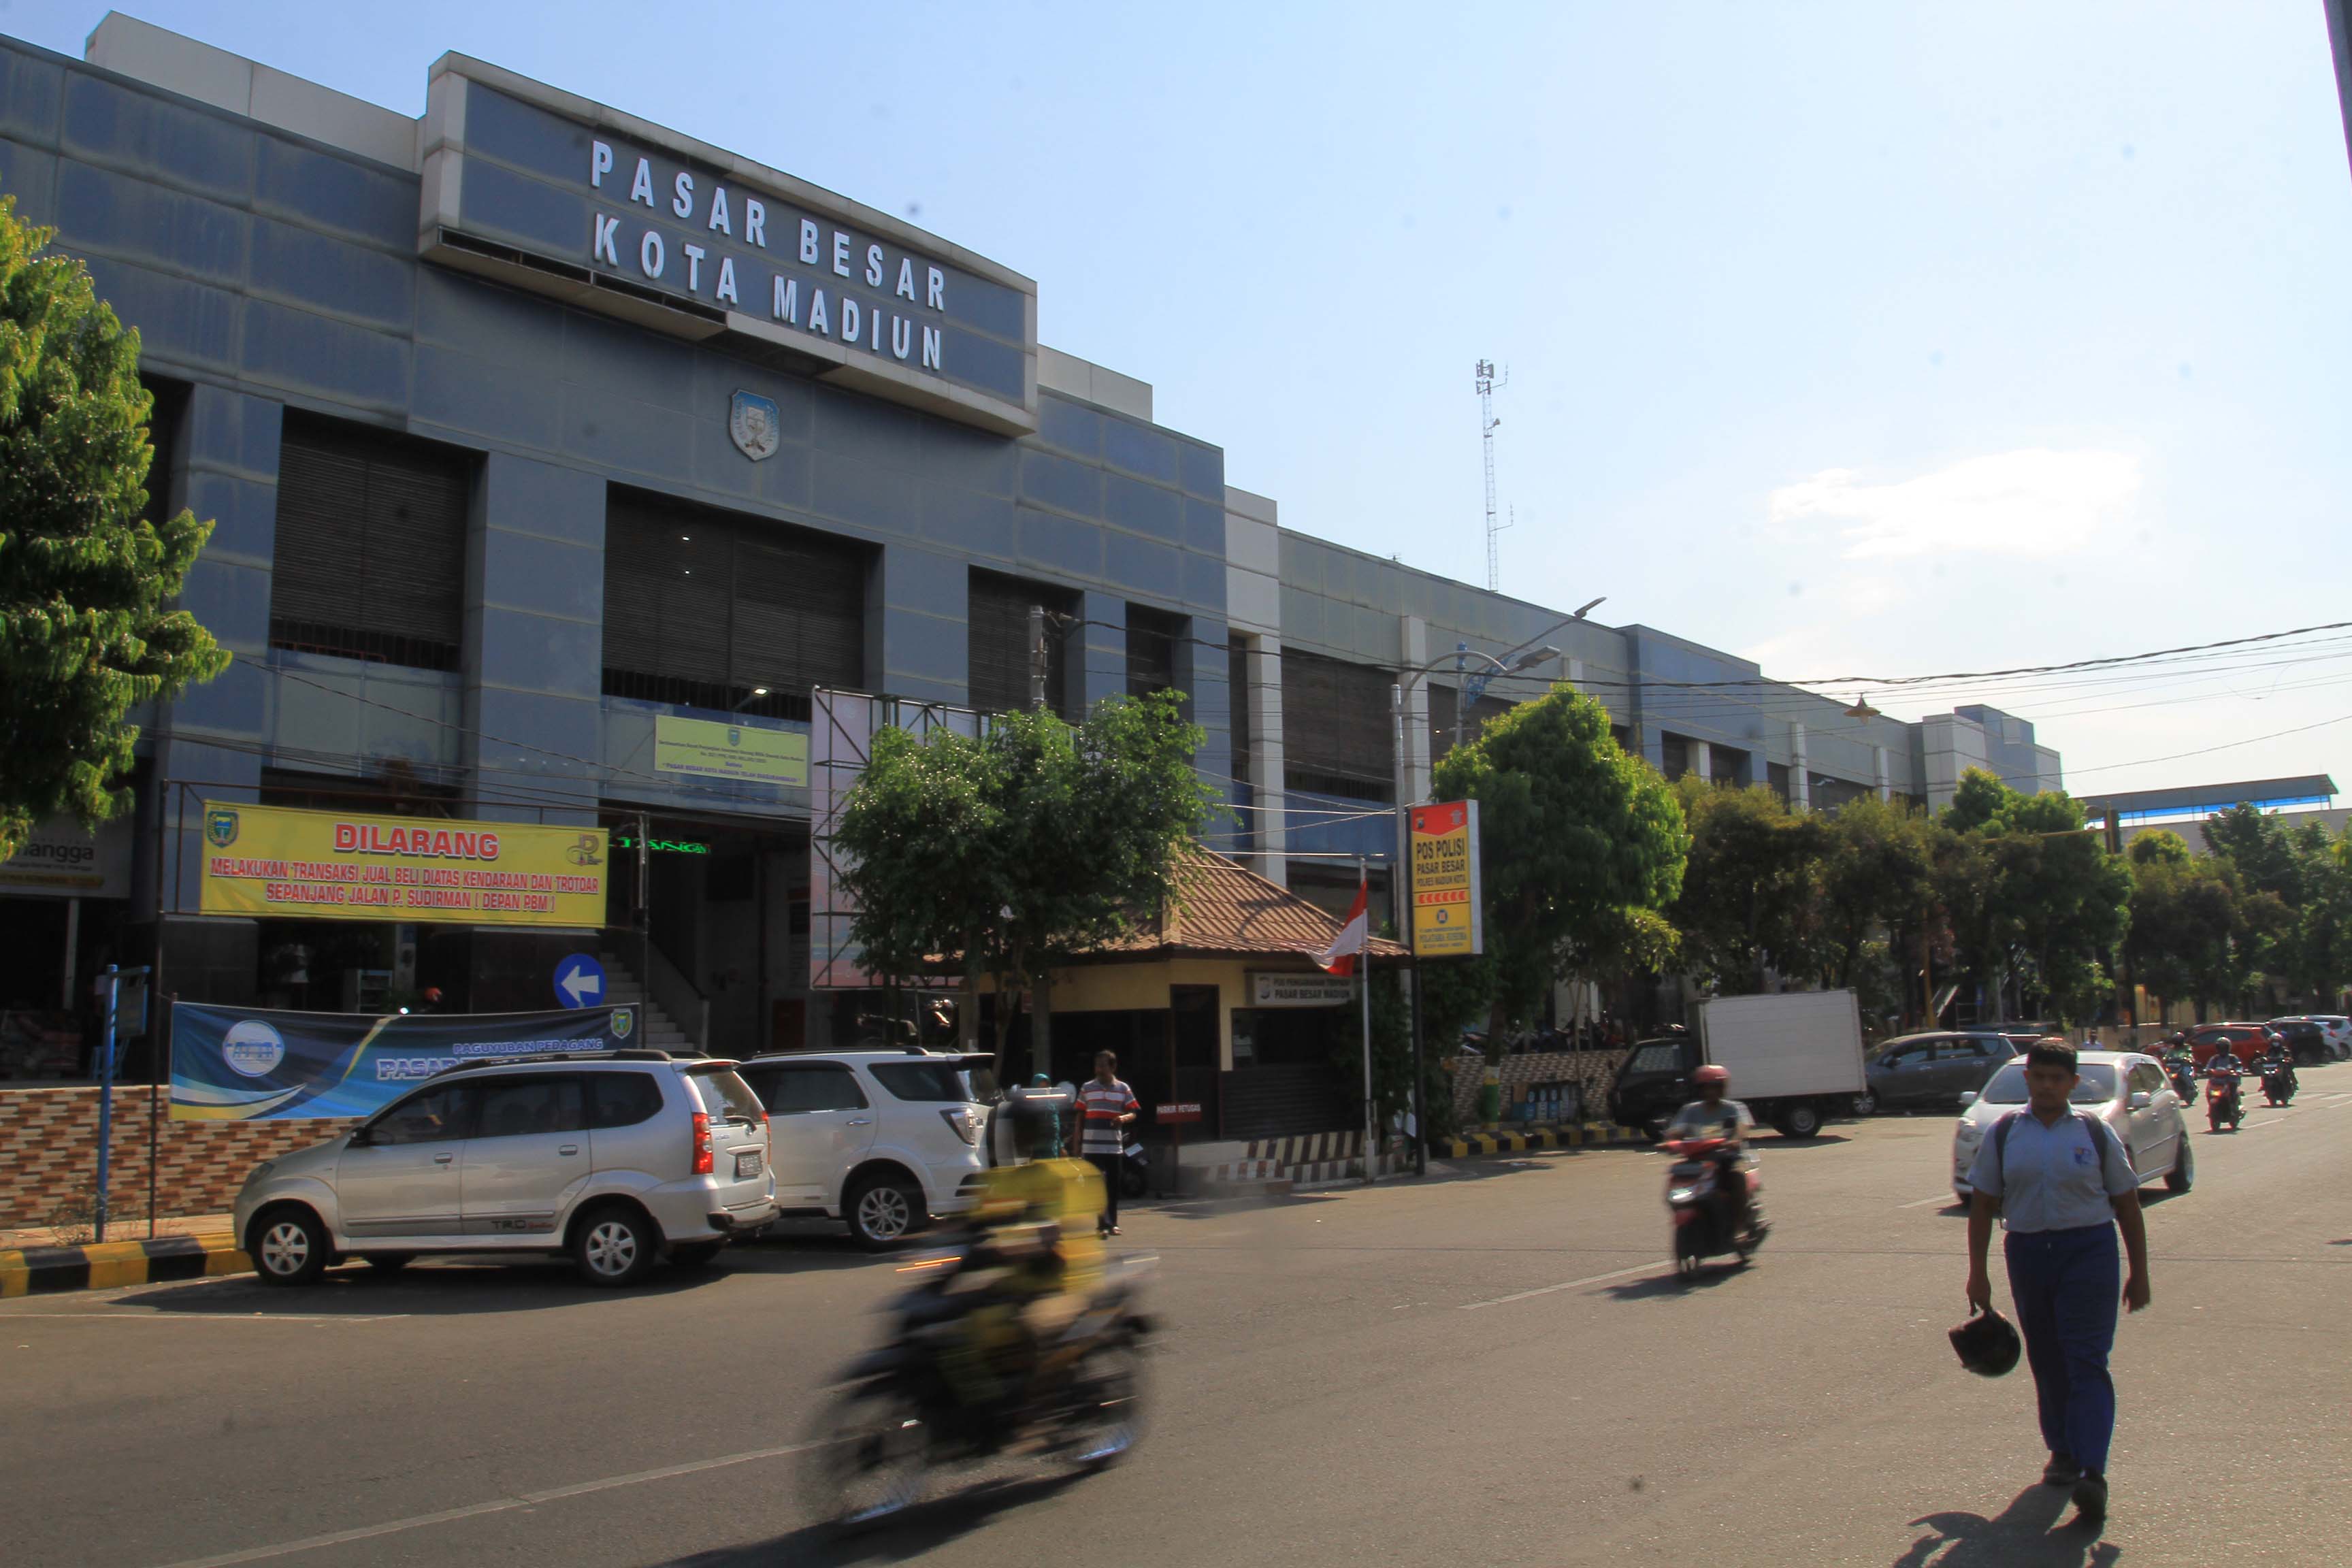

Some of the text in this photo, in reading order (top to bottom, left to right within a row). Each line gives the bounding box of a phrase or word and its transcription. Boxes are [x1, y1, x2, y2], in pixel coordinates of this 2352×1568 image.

[591, 140, 945, 312] PASAR BESAR
[594, 212, 941, 371] KOTA MADIUN
[333, 822, 500, 860] DILARANG
[1416, 837, 1465, 860] POS POLISI
[210, 856, 599, 894] MELAKUKAN TRANSAKSI JUAL BELI DIATAS KENDARAAN DAN TROTOAR
[1416, 859, 1465, 875] PASAR BESAR
[265, 882, 344, 904] SEPANJANG
[348, 886, 389, 905] JALAN
[391, 888, 403, 906] P.
[408, 889, 471, 909] SUDIRMAN
[1275, 989, 1297, 999] PASAR
[1299, 989, 1322, 999] BESAR
[453, 1039, 604, 1055] PAGUYUBAN PEDAGANG
[491, 1220, 525, 1230] TRD
